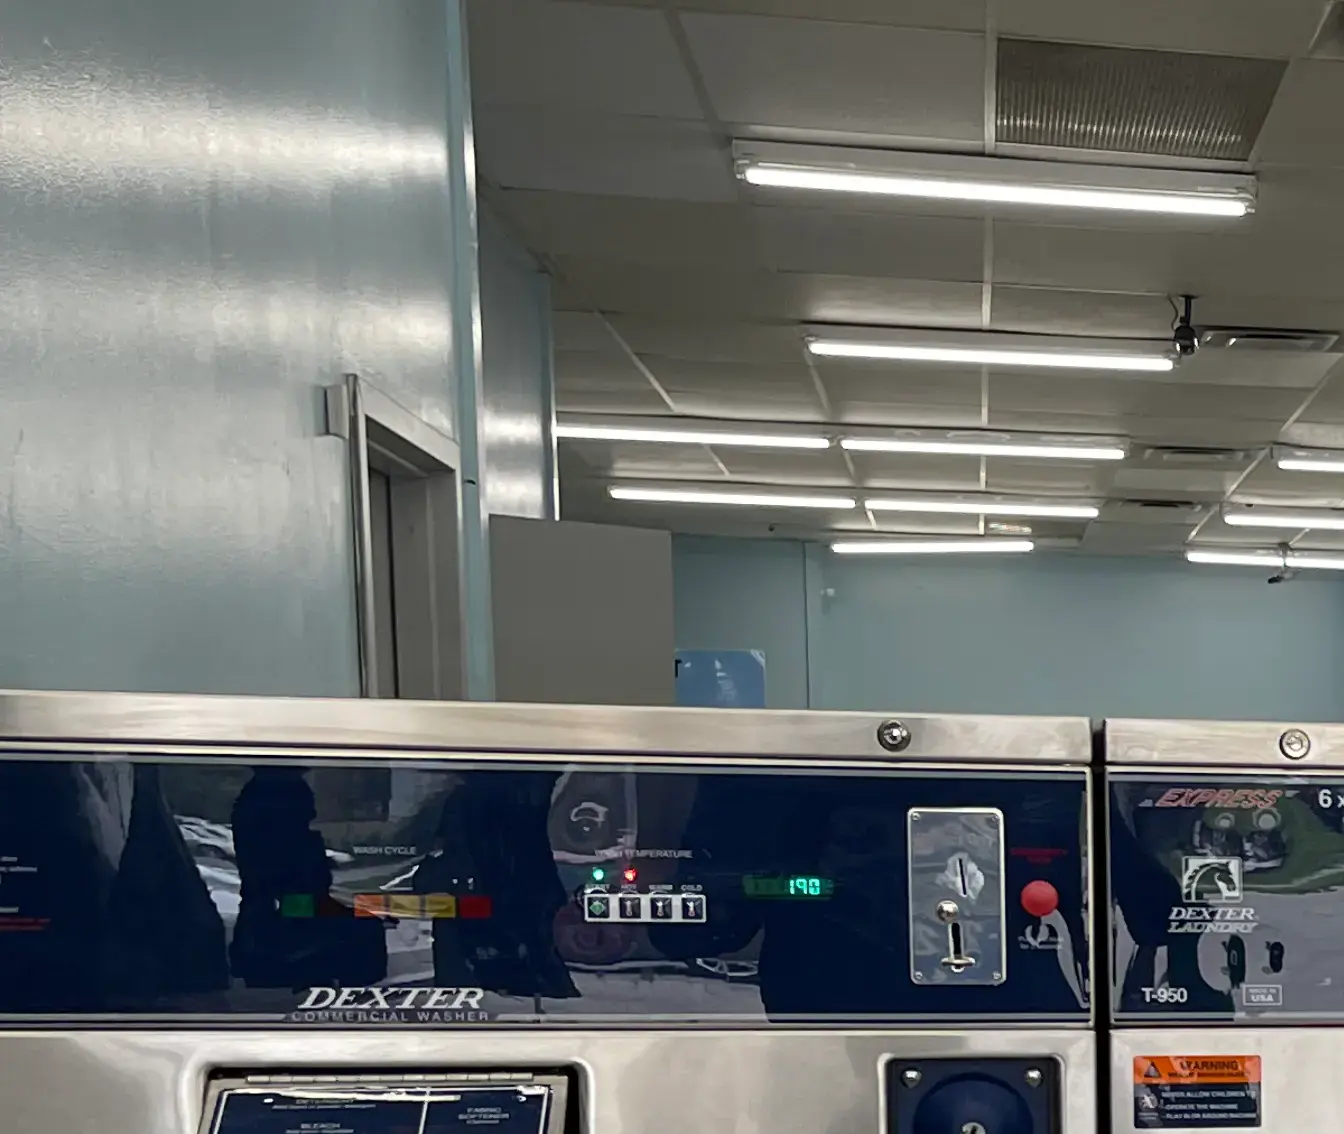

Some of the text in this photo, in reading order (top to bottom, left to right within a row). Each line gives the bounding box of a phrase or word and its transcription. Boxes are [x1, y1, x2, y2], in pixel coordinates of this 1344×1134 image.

[1155, 788, 1283, 808] EXPRESS
[1318, 789, 1332, 808] 6
[384, 847, 416, 855] CYCLE
[790, 879, 819, 895] 190
[1169, 907, 1255, 920] DEXTER
[1168, 922, 1258, 933] LAUNDRY
[298, 987, 484, 1009] DEXTER
[1141, 987, 1188, 1002] T-950
[292, 1011, 488, 1022] COMMERCIAL WASHER
